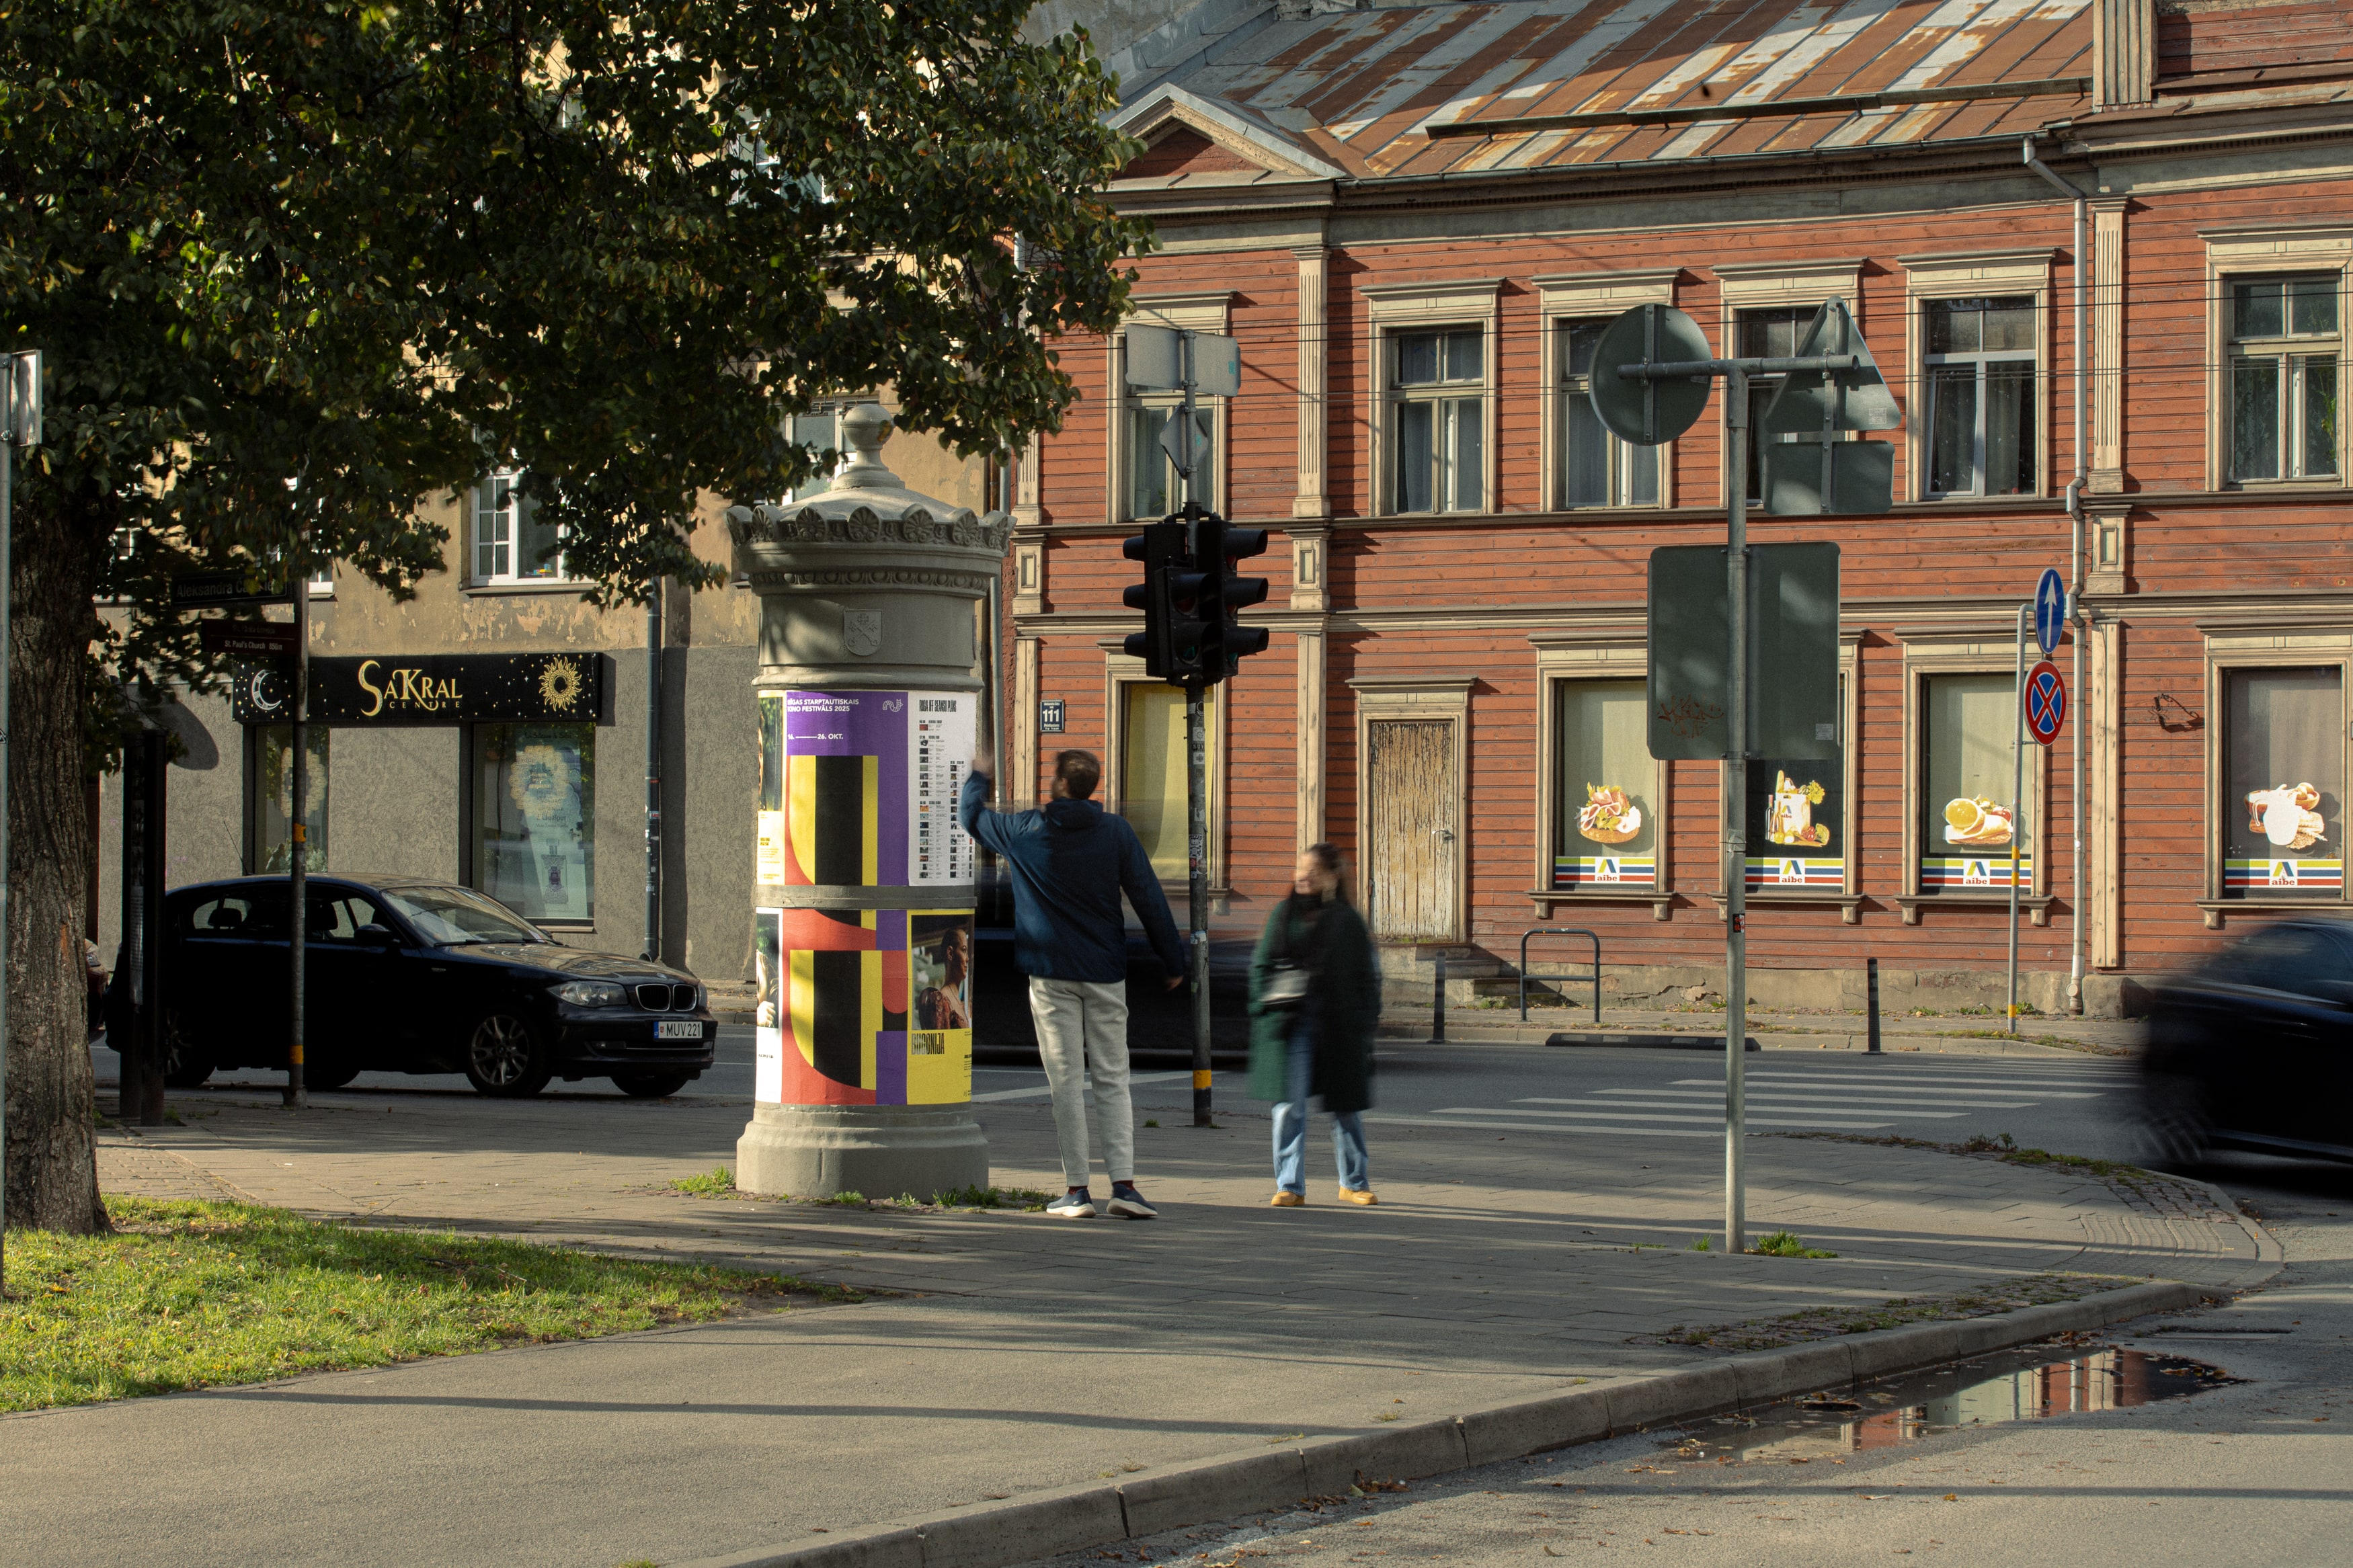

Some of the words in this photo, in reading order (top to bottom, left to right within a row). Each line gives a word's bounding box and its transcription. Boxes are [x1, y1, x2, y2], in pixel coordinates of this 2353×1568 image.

[176, 581, 233, 597] Aleksandra
[233, 640, 248, 649] Paul's
[249, 641, 266, 650] Church
[358, 660, 463, 716] SAKRAL
[389, 700, 461, 709] CENTRE
[801, 704, 833, 712] FESTIVĀLS
[1042, 708, 1060, 723] 111
[2272, 878, 2295, 886] aibe
[666, 1023, 686, 1037] MUV
[687, 1023, 701, 1036] 221
[911, 1032, 945, 1055] BUGONIJA
